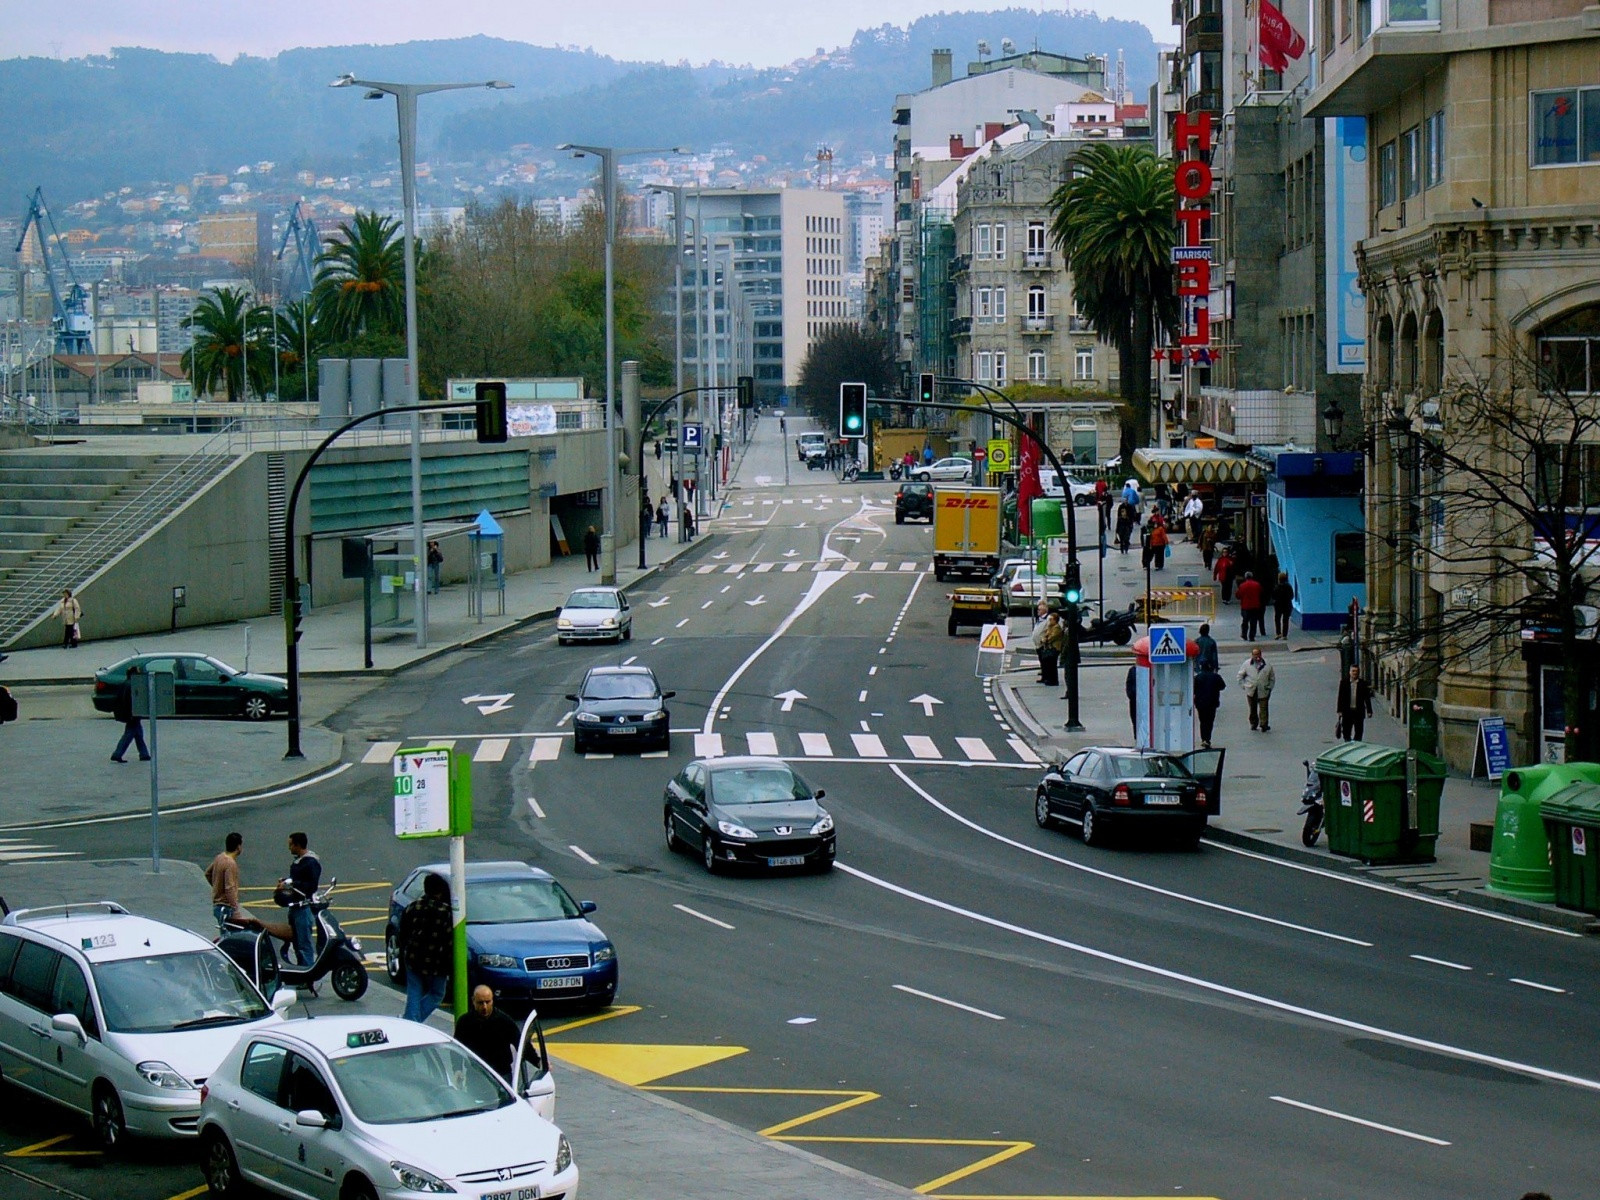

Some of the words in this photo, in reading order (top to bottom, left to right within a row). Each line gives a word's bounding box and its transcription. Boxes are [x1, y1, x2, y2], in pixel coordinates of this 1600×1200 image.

[686, 427, 697, 441] P
[945, 498, 990, 509] DHL
[396, 776, 412, 794] 10
[416, 779, 426, 790] 28
[93, 933, 116, 946] 123
[542, 978, 564, 988] 0283
[360, 1030, 384, 1045] 123
[518, 1188, 537, 1200] DGN
